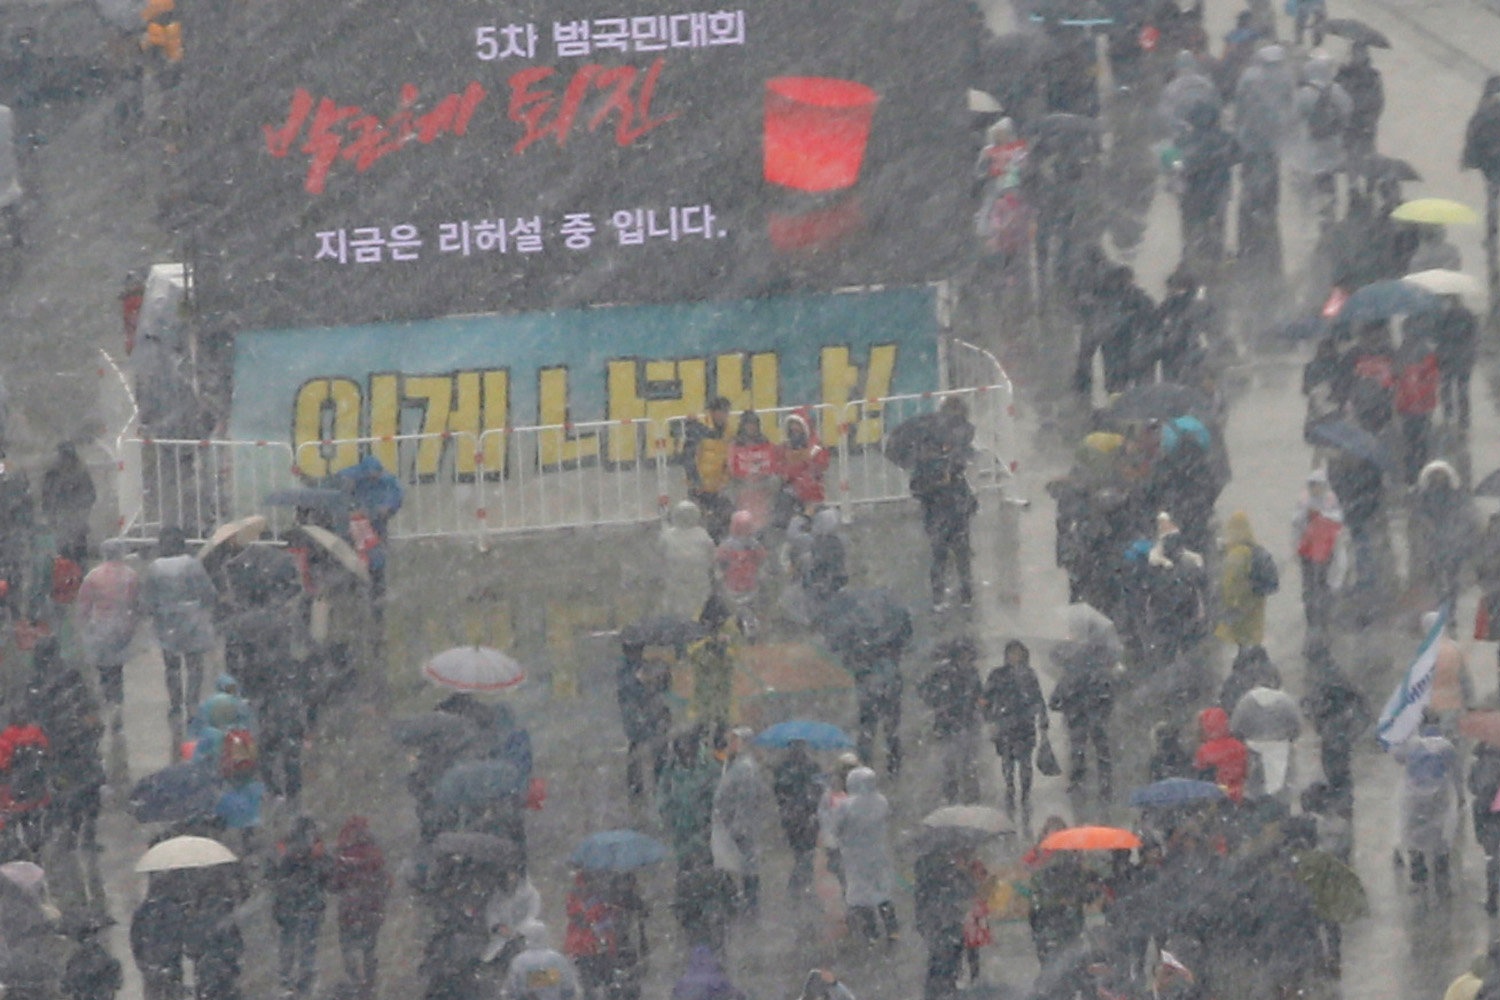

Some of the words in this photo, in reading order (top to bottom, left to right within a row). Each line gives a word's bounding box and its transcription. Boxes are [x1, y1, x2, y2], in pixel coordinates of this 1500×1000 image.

[476, 22, 539, 61] 5차
[552, 9, 746, 58] 범국민대회
[263, 82, 487, 195] 박근혜
[508, 57, 684, 155] 퇴진
[314, 225, 423, 265] 지금은
[438, 216, 545, 256] 리허설
[559, 212, 597, 251] 중
[612, 203, 728, 245] 입니다.
[292, 366, 510, 485] 이게
